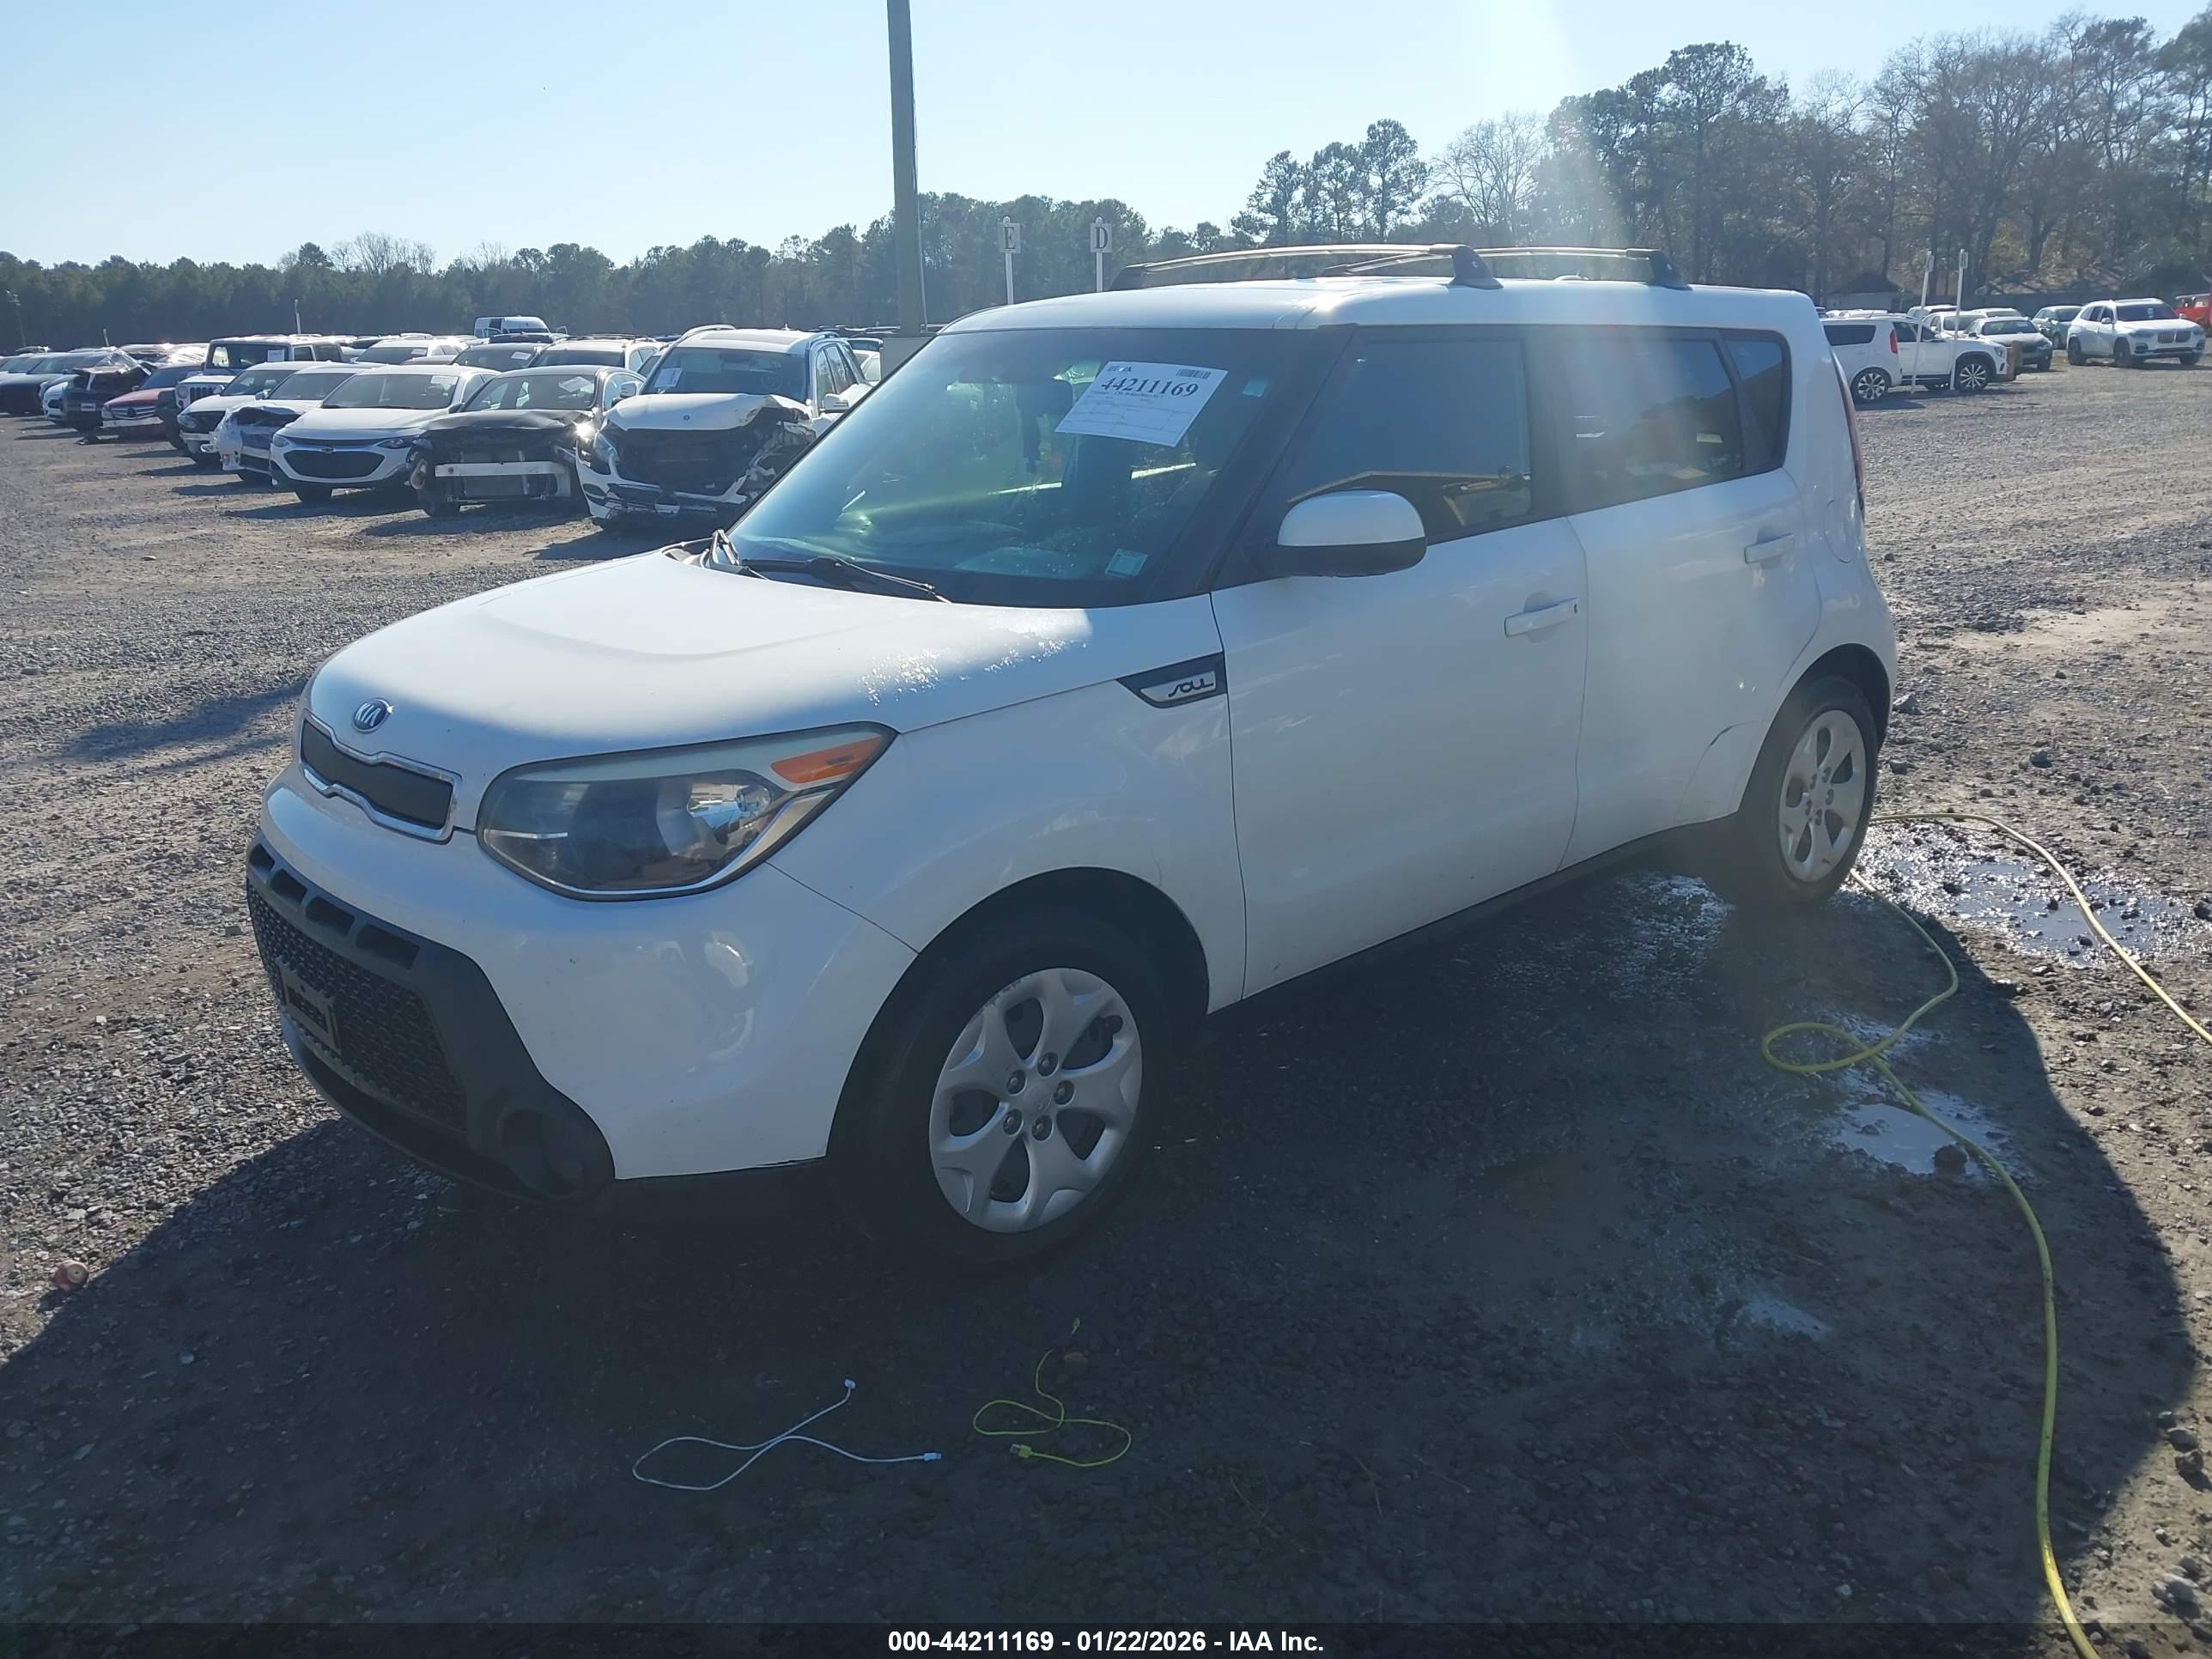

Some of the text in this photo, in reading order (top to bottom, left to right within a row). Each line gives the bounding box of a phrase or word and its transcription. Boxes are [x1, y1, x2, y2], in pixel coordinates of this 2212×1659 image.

[1003, 226, 1017, 250] E
[1095, 226, 1109, 249] D
[1101, 377, 1199, 398] 44211169
[1168, 678, 1214, 698] SOUL
